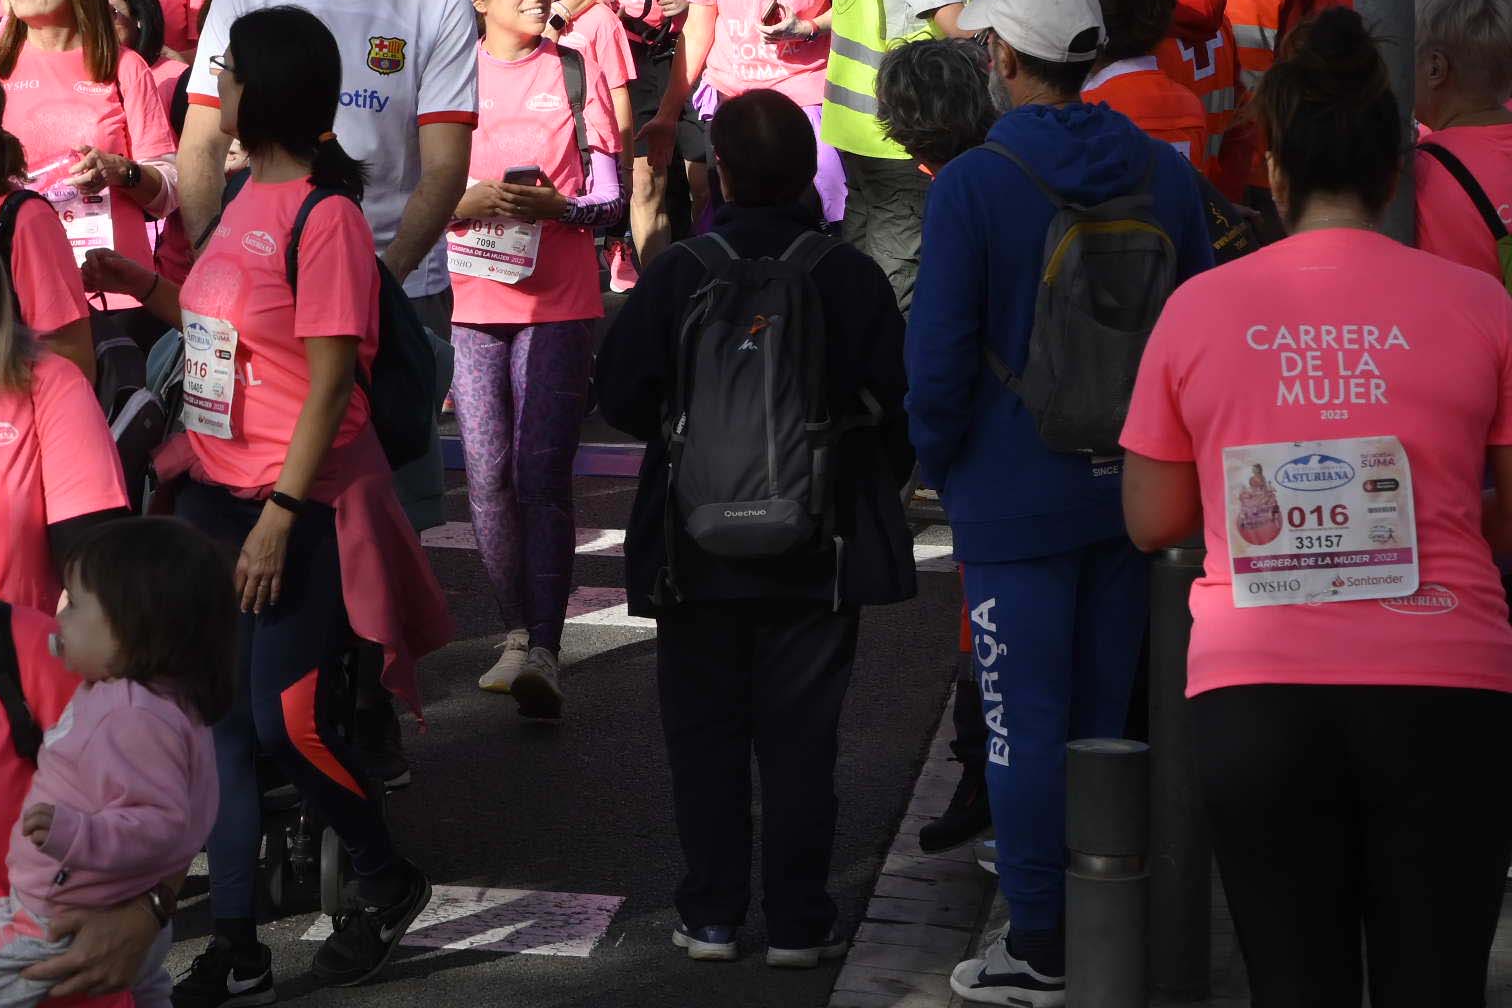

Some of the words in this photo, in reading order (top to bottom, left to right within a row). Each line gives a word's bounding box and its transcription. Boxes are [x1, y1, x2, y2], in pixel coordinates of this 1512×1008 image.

[338, 88, 390, 113] otify
[476, 237, 496, 248] 7098
[451, 244, 472, 256] CARRERA
[472, 248, 481, 257] DE
[490, 252, 510, 262] MUJER
[1246, 324, 1410, 350] CARRERA
[186, 358, 208, 378] 016
[1281, 351, 1323, 377] DE
[1338, 351, 1381, 376] LA
[1277, 378, 1388, 406] MUJER
[1320, 409, 1349, 420] 2023
[1092, 465, 1119, 477] SINCE
[1281, 470, 1349, 484] ASTURIANA
[1360, 457, 1396, 469] SUMA
[724, 509, 767, 517] Quechua
[1288, 504, 1349, 528] 016
[1295, 535, 1343, 550] 33157
[1250, 558, 1298, 569] CARRERA
[1301, 556, 1316, 567] DE
[1318, 555, 1331, 565] LA
[1334, 554, 1370, 565] MUJER
[1374, 552, 1398, 562] 2023
[1248, 579, 1301, 594] OYSHO
[1346, 574, 1404, 587] Santander
[970, 597, 1010, 767] BARÇA
